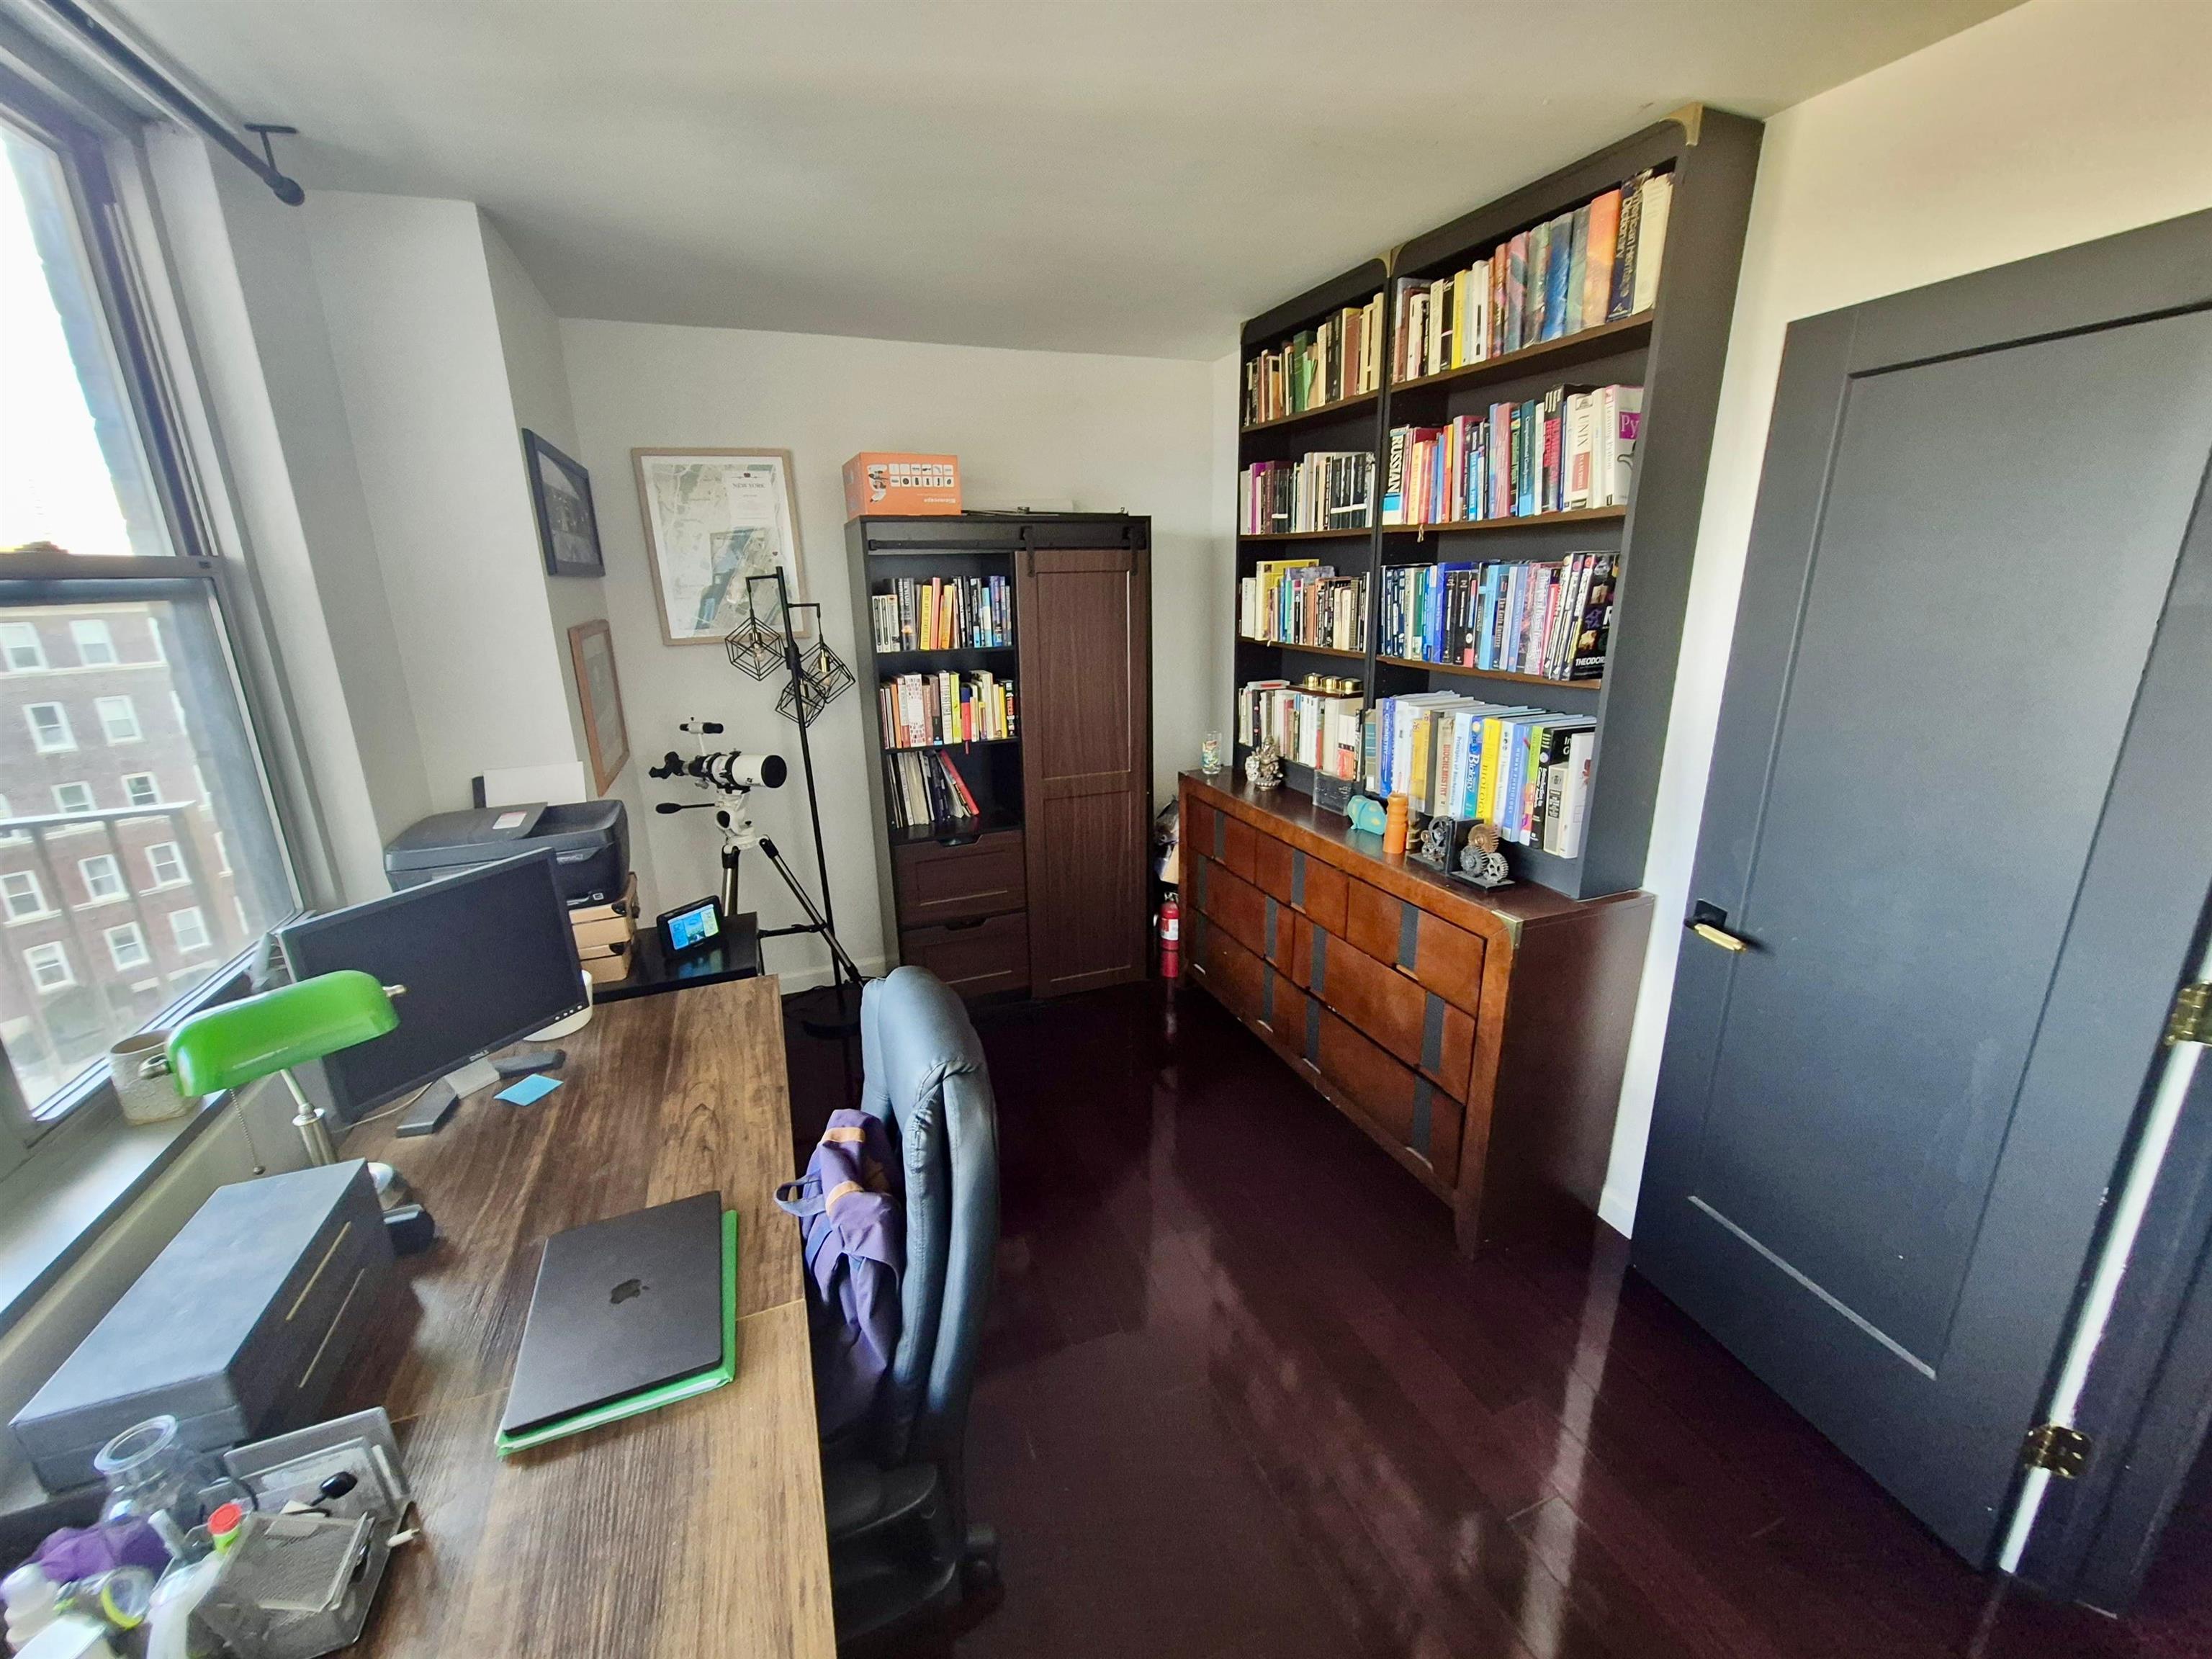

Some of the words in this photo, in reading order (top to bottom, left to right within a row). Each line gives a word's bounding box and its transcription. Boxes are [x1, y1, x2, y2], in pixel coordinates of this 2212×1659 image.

[1577, 414, 1590, 447] UNIX
[1388, 436, 1403, 493] RUSSIAN
[1439, 744, 1451, 796] BIOCHEMISTRY
[1467, 753, 1480, 792] Biology
[1478, 765, 1488, 819] BIOLOGY
